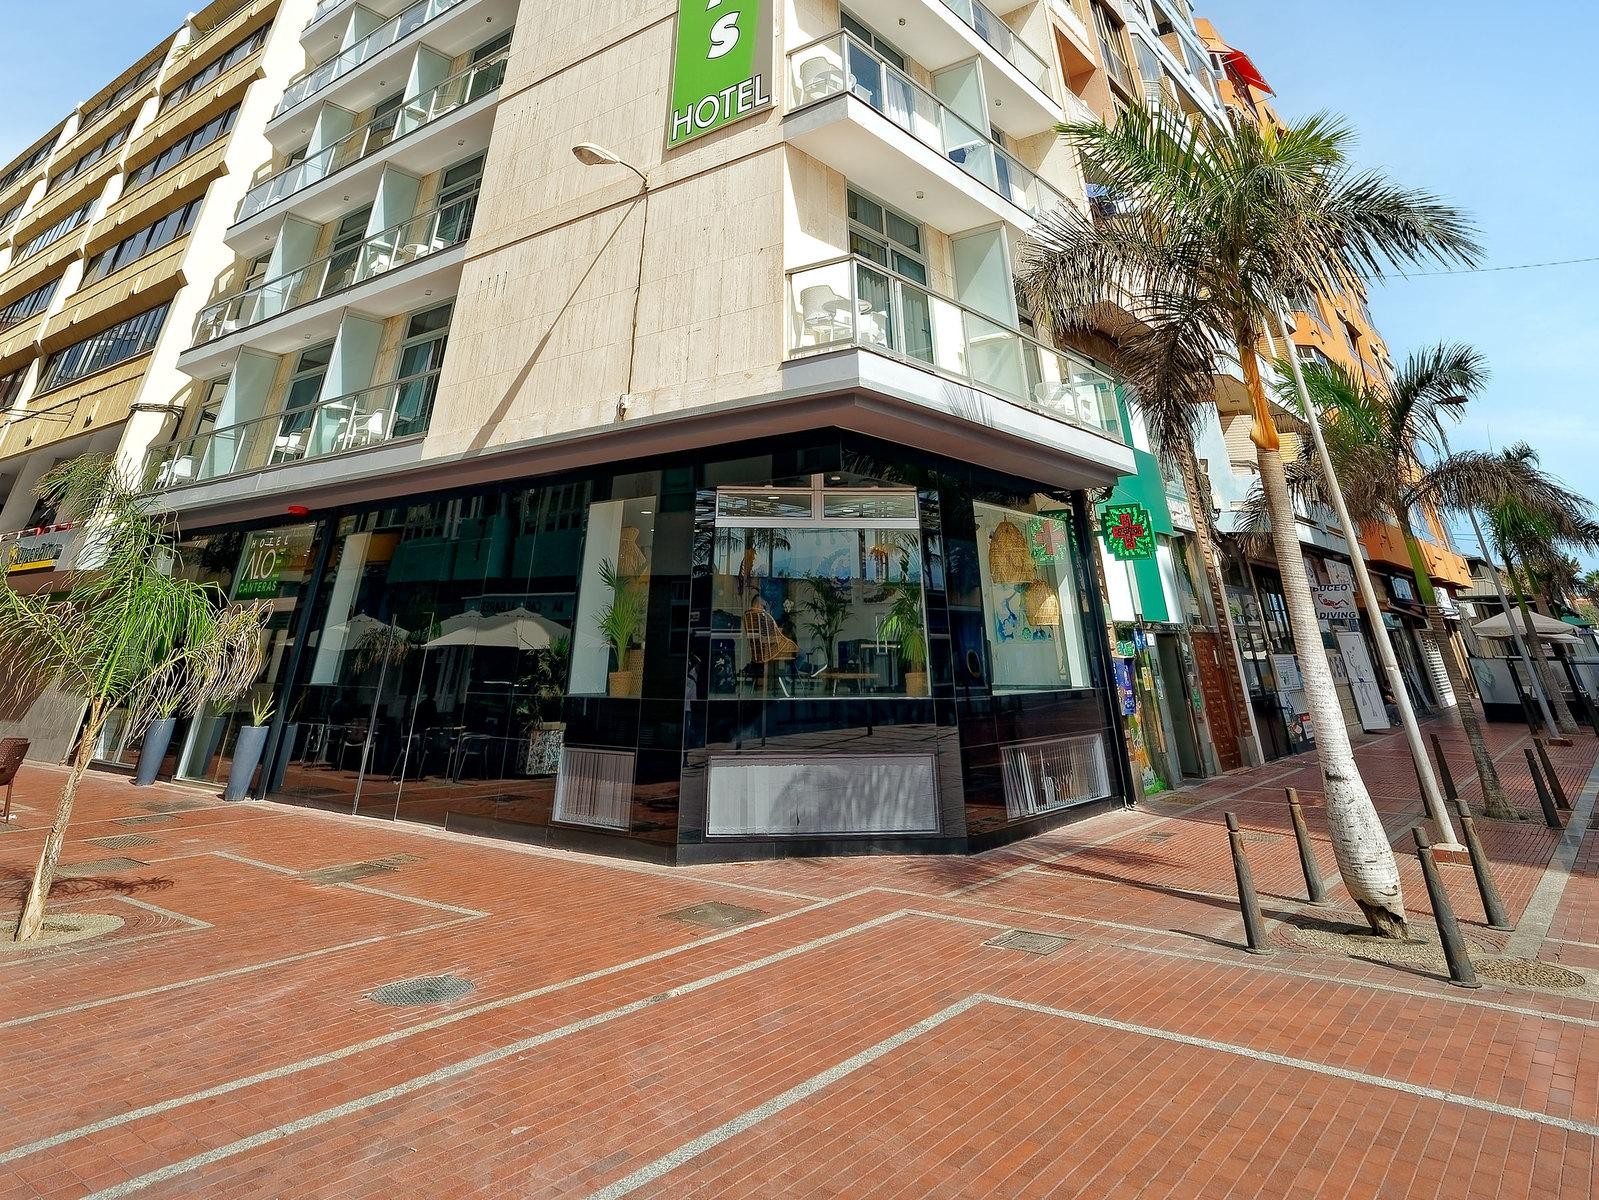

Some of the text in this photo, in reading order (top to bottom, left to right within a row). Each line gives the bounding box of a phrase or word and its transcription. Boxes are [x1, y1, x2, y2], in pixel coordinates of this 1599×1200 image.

[671, 73, 771, 142] HOTEL
[250, 535, 289, 549] HOTEL
[238, 580, 278, 593] CANTERAS
[1319, 611, 1356, 619] DIVING
